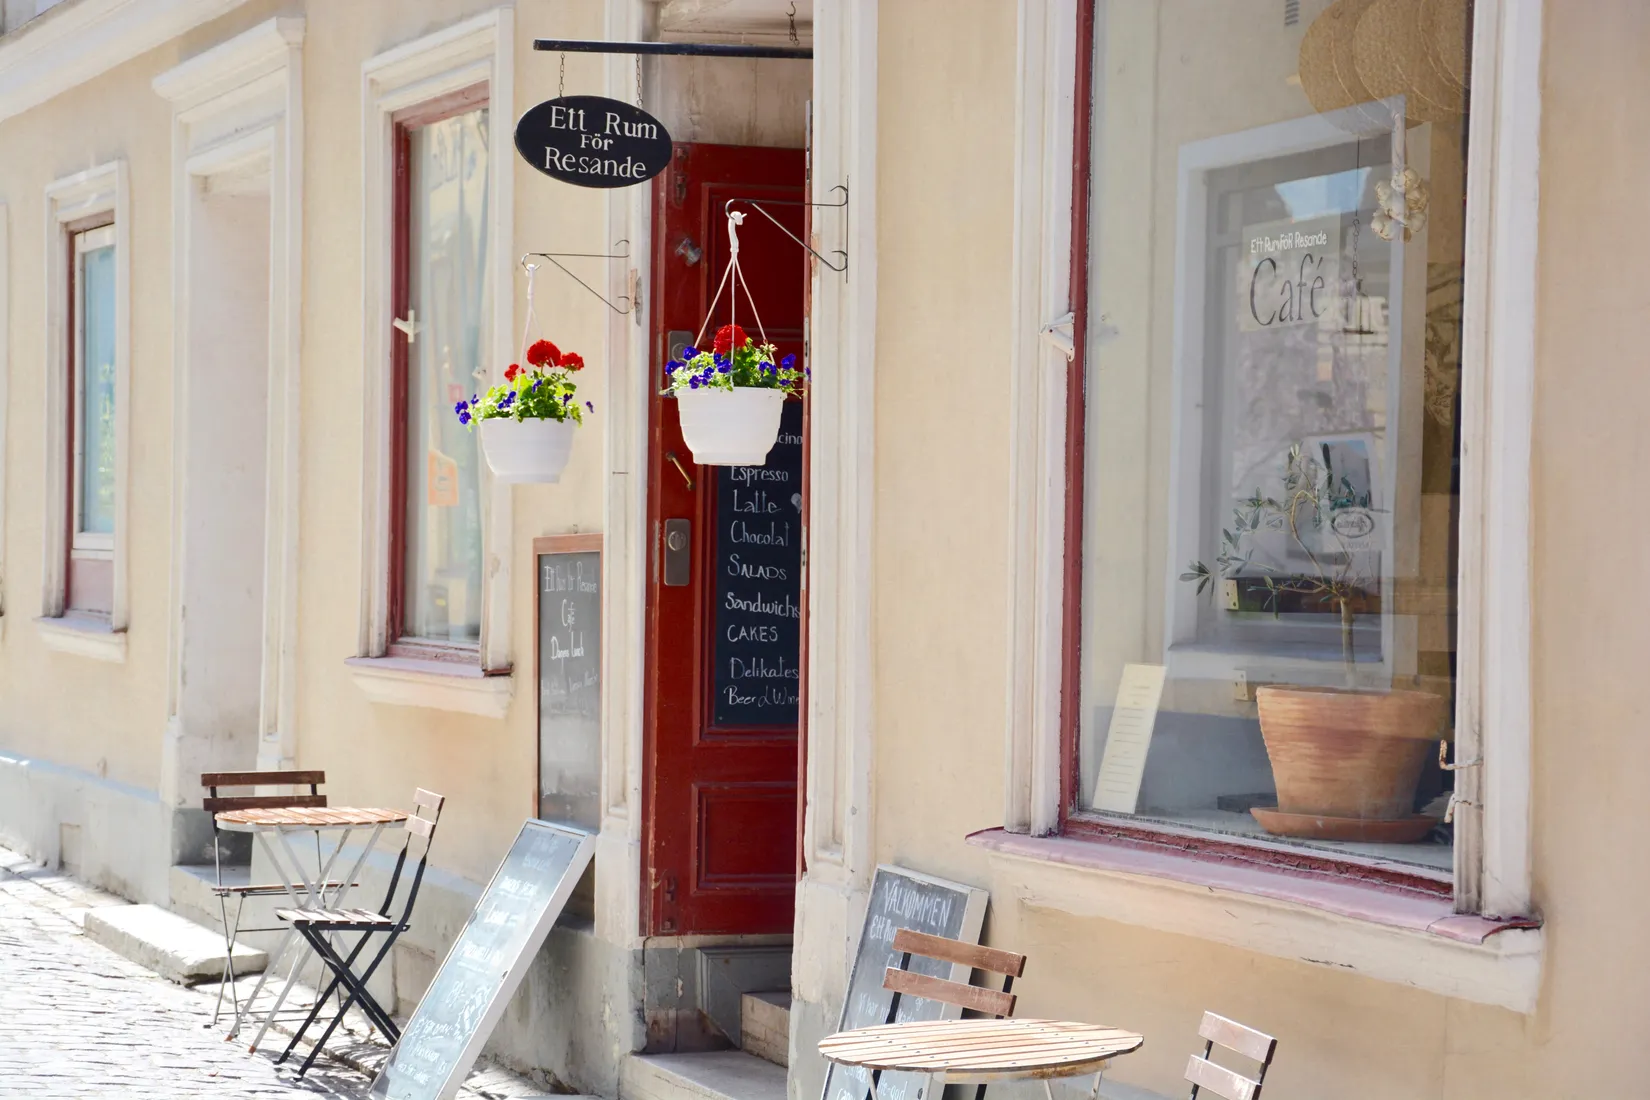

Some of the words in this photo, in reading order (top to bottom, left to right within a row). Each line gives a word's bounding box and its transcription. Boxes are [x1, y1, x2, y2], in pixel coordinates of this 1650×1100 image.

[550, 106, 587, 132] Ett
[604, 112, 658, 140] Rum
[580, 133, 613, 151] För
[544, 146, 647, 179] Resande
[1250, 237, 1264, 253] Ett
[1295, 229, 1328, 249] Resande
[1250, 253, 1327, 326] Café
[730, 466, 789, 487] Espresso
[733, 489, 781, 513] Latte
[727, 624, 779, 642] CAKES
[723, 684, 757, 706] Beer
